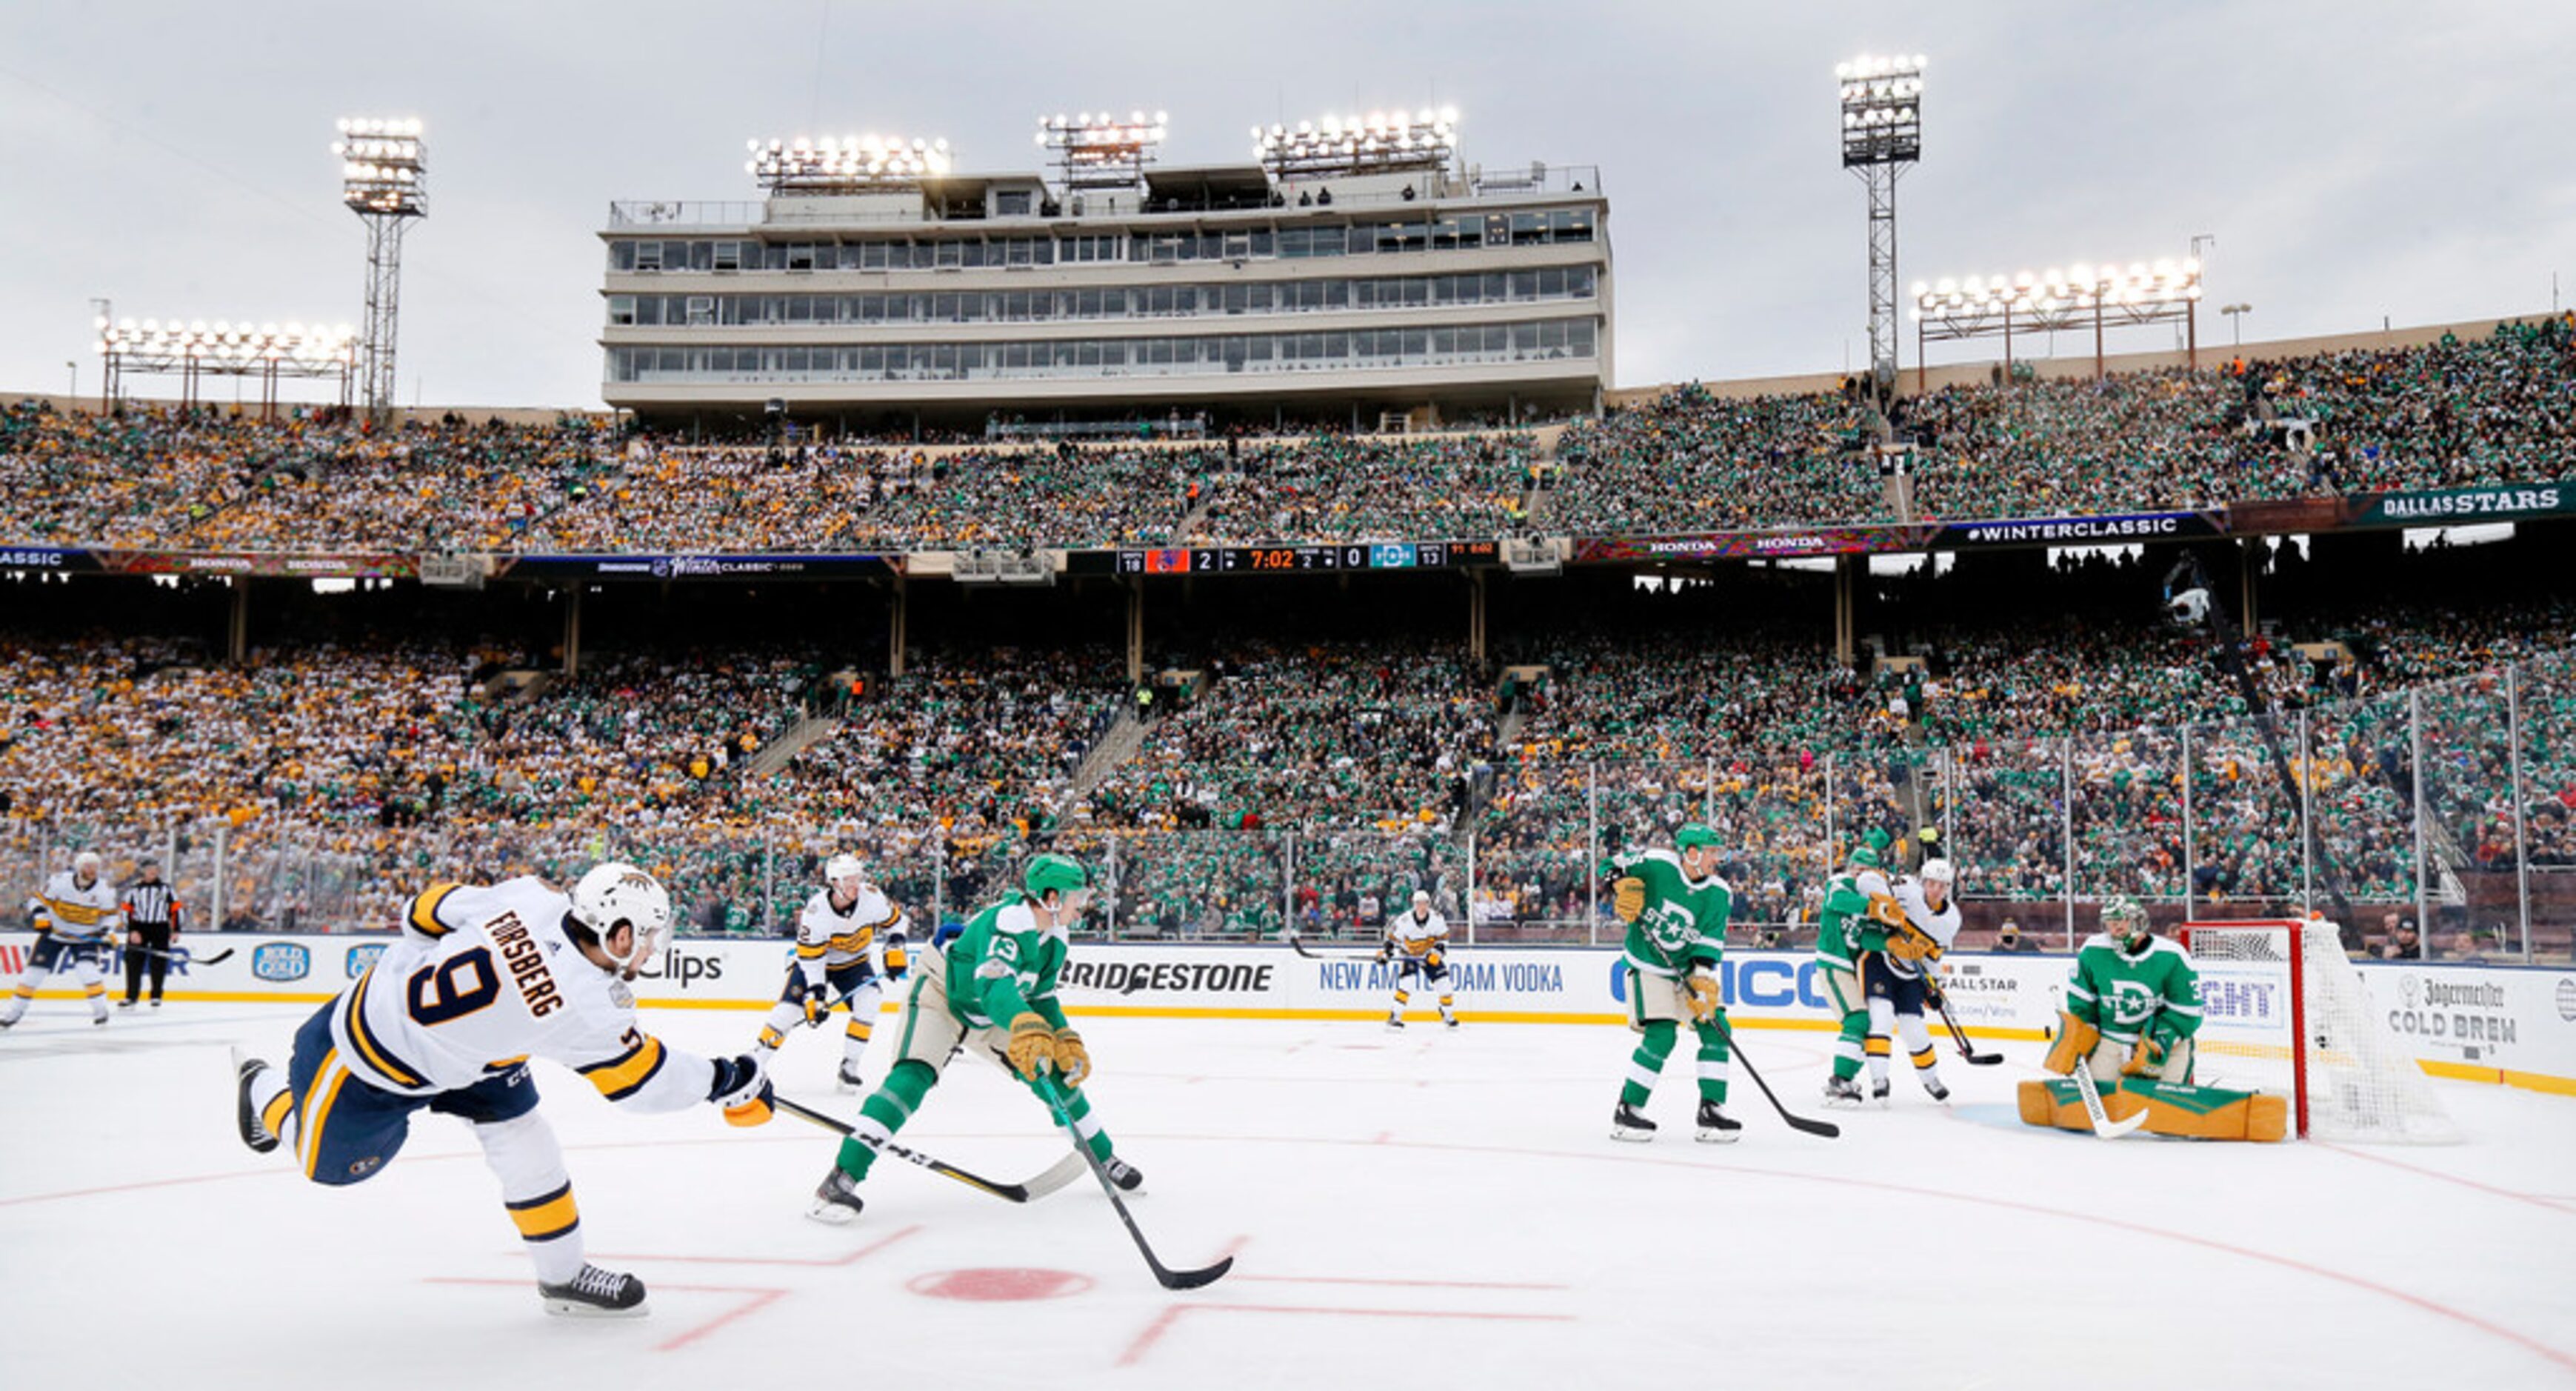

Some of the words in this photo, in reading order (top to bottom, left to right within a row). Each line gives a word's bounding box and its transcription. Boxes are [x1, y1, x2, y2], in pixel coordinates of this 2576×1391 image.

[2383, 496, 2453, 516] DALLAS
[2455, 489, 2559, 513] STARS
[1967, 518, 2178, 542] #WINTERCLASSIC
[1650, 541, 1717, 553] HONDA
[1757, 536, 1825, 550] HONDA
[190, 557, 252, 570] HONDA
[287, 559, 349, 570] HONDA
[1199, 553, 1211, 570] 2
[1250, 550, 1294, 568] 7:02
[1303, 556, 1312, 569] 2
[1348, 547, 1361, 566] 0
[986, 934, 1019, 962] 13
[484, 910, 564, 1018] FORSBERG
[407, 945, 502, 1027] 9
[1320, 962, 1363, 990] NEW
[1368, 962, 1495, 992] AMTEDAM
[1503, 963, 1564, 992] VODKA
[1610, 961, 1832, 1008] ICO
[2389, 1010, 2446, 1036] COLD
[2454, 1014, 2517, 1044] BREW
